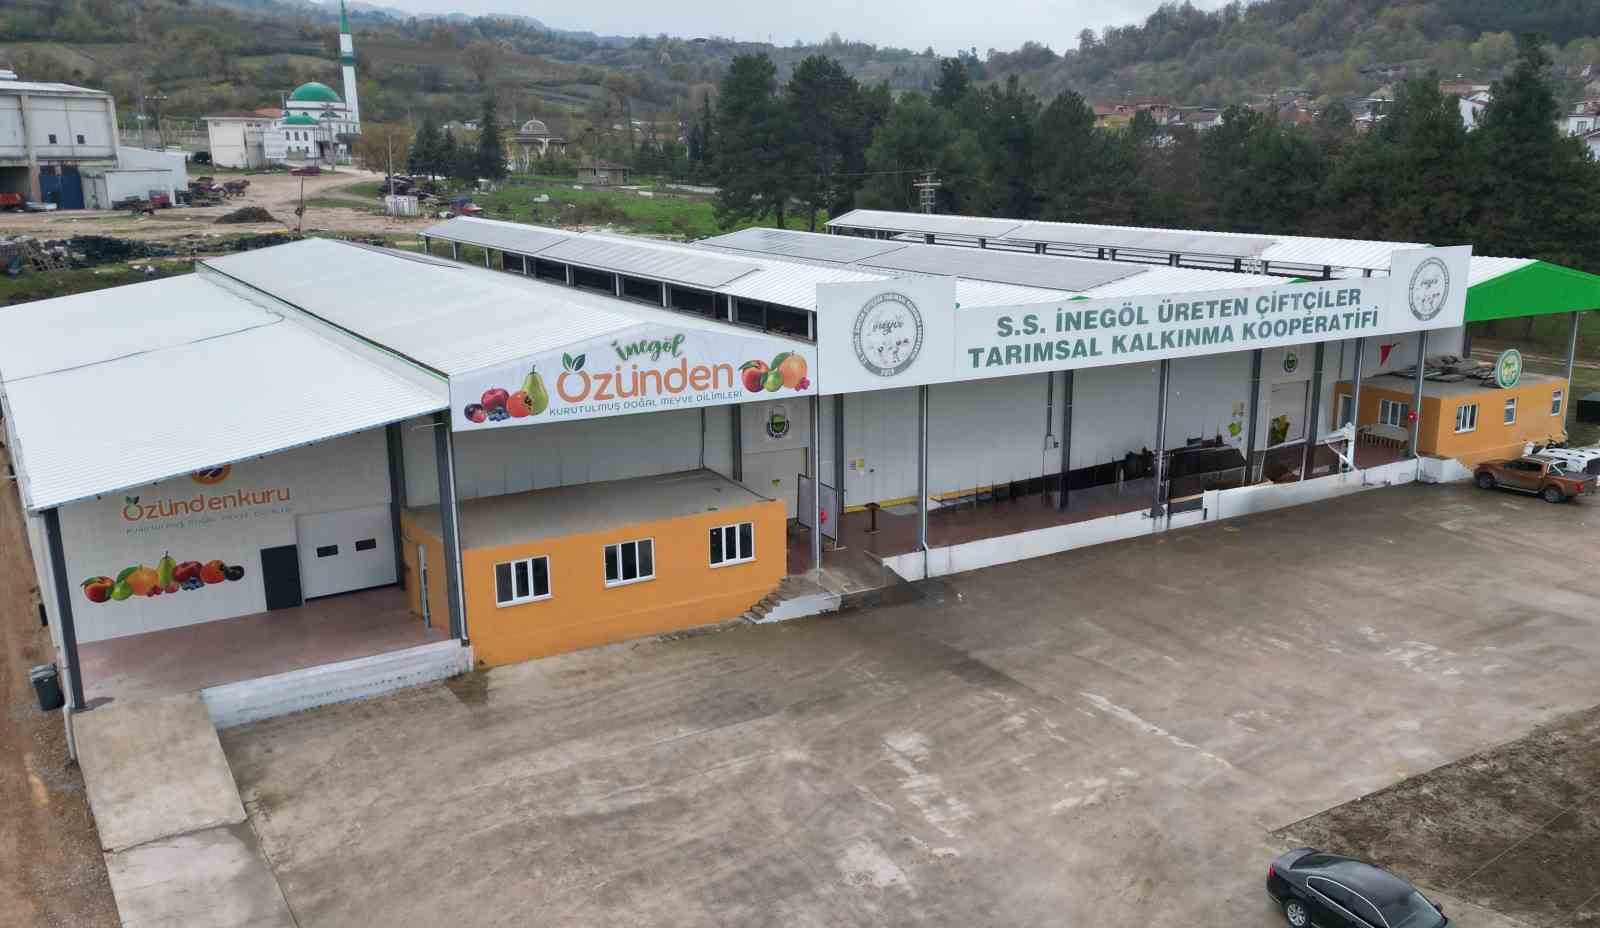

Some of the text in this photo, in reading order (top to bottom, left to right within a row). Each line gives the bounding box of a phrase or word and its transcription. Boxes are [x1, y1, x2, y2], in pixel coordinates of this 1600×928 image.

[968, 305, 1379, 369] TARIMSAL KALKINMA KOOPERATİFİ
[997, 287, 1362, 338] S.S. İNEGÖL ÜRETEN ÇİFTÇİLER
[550, 401, 621, 416] KURUTULMUŞ
[623, 397, 657, 409] DOĞAL
[660, 394, 693, 406] MEYVE
